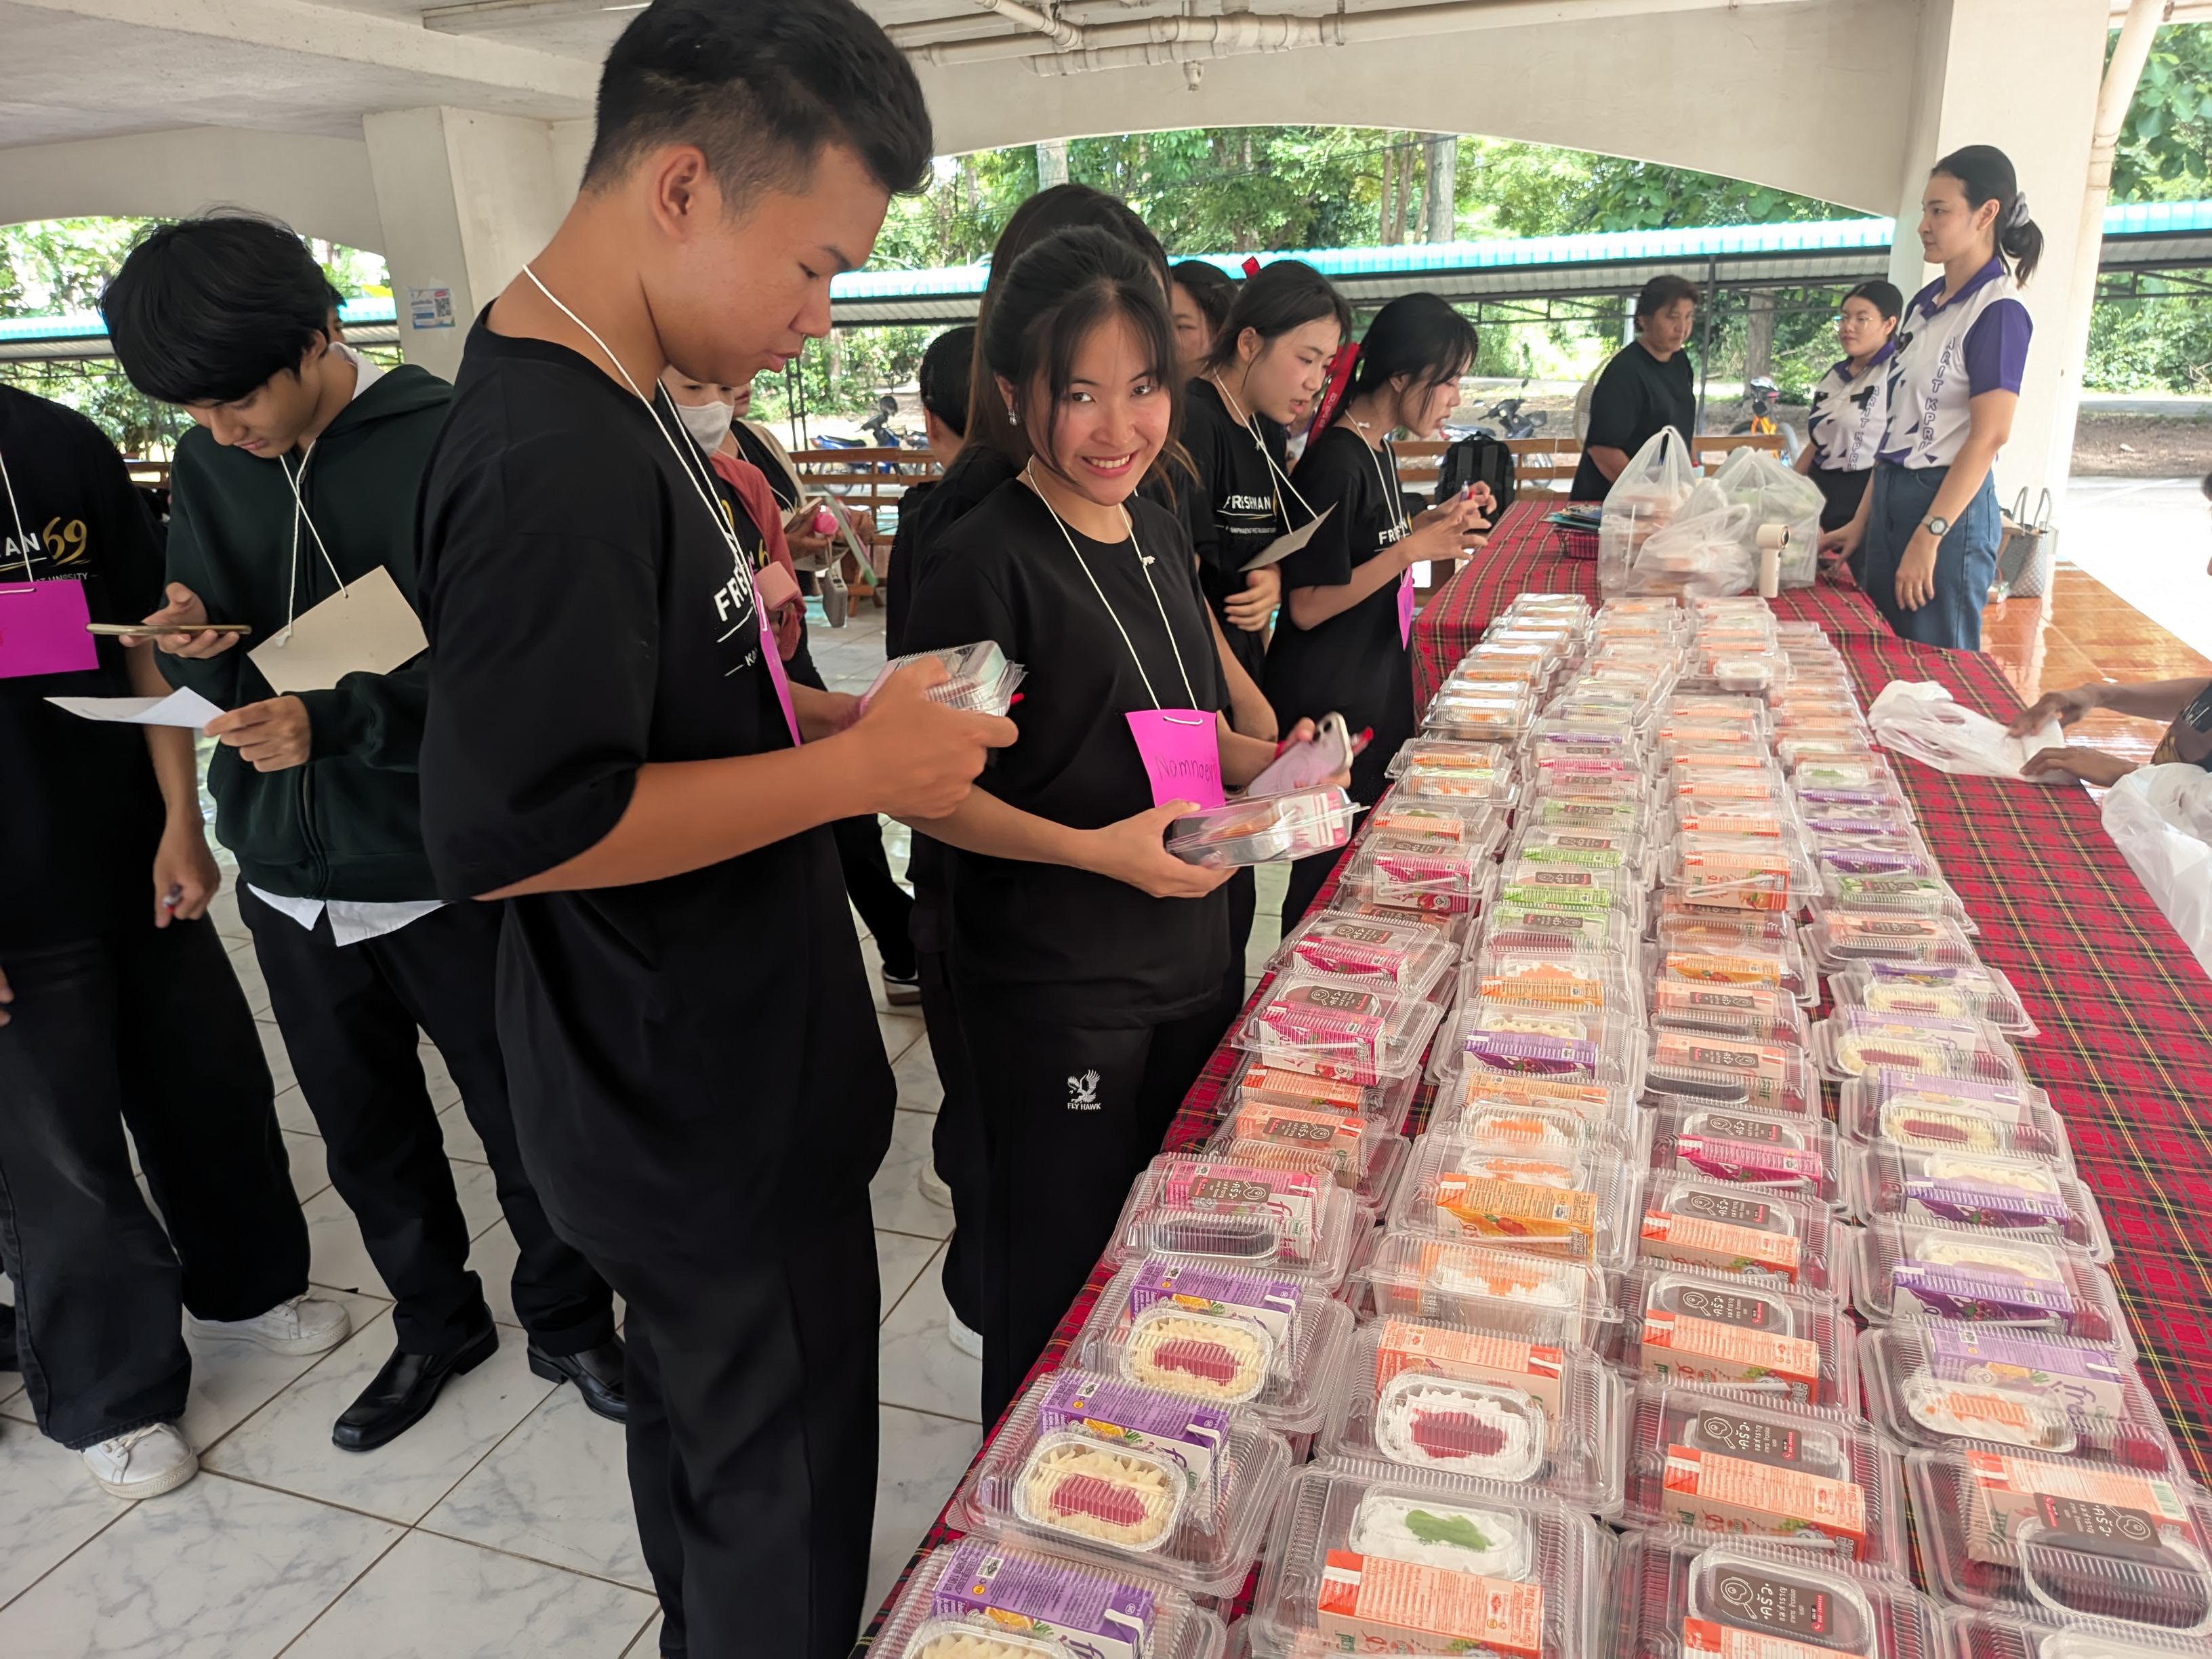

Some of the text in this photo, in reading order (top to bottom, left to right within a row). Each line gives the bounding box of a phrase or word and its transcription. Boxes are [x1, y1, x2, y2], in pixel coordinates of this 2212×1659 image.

[0, 516, 87, 566] AN 69
[1067, 1102, 1079, 1110] FLY
[1736, 1424, 1750, 1448] ครัว
[1757, 1586, 1774, 1617] ครัว
